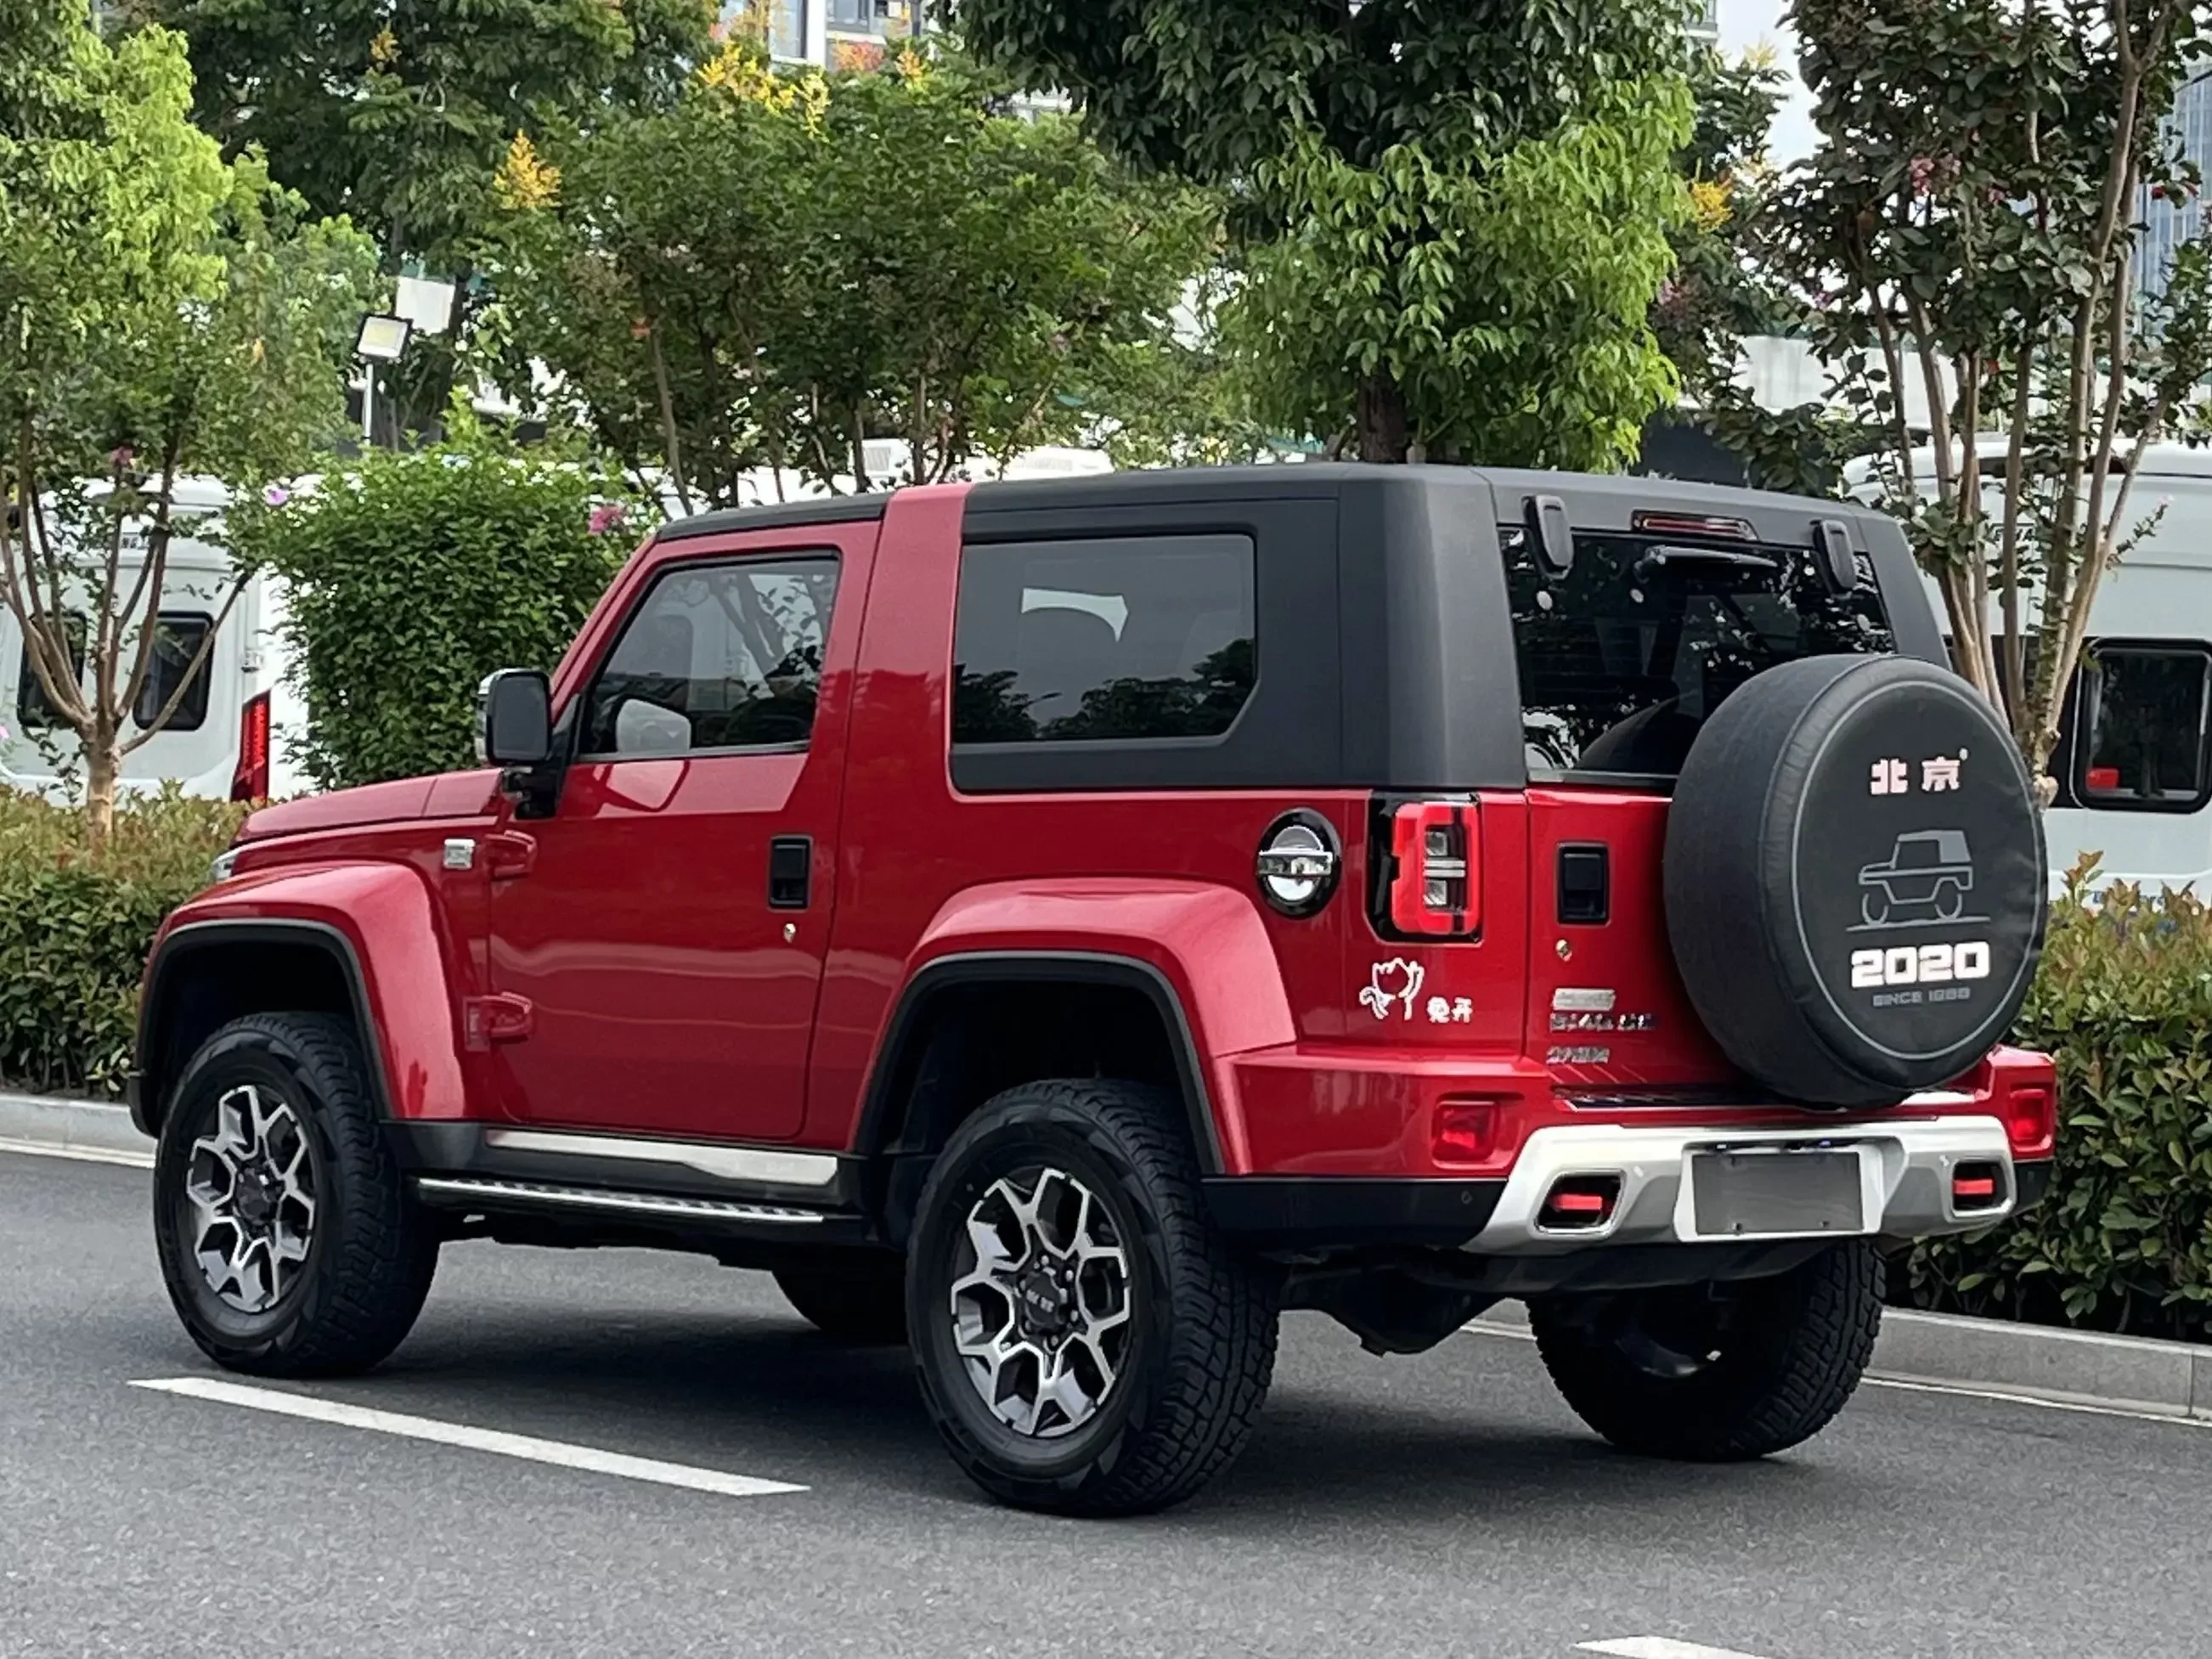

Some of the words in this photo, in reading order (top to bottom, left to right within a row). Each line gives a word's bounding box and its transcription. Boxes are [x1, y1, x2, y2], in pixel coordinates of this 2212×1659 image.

[1870, 754, 1961, 795] 北京
[1850, 940, 1990, 989] 2020
[1872, 990, 1923, 1007] SINCE
